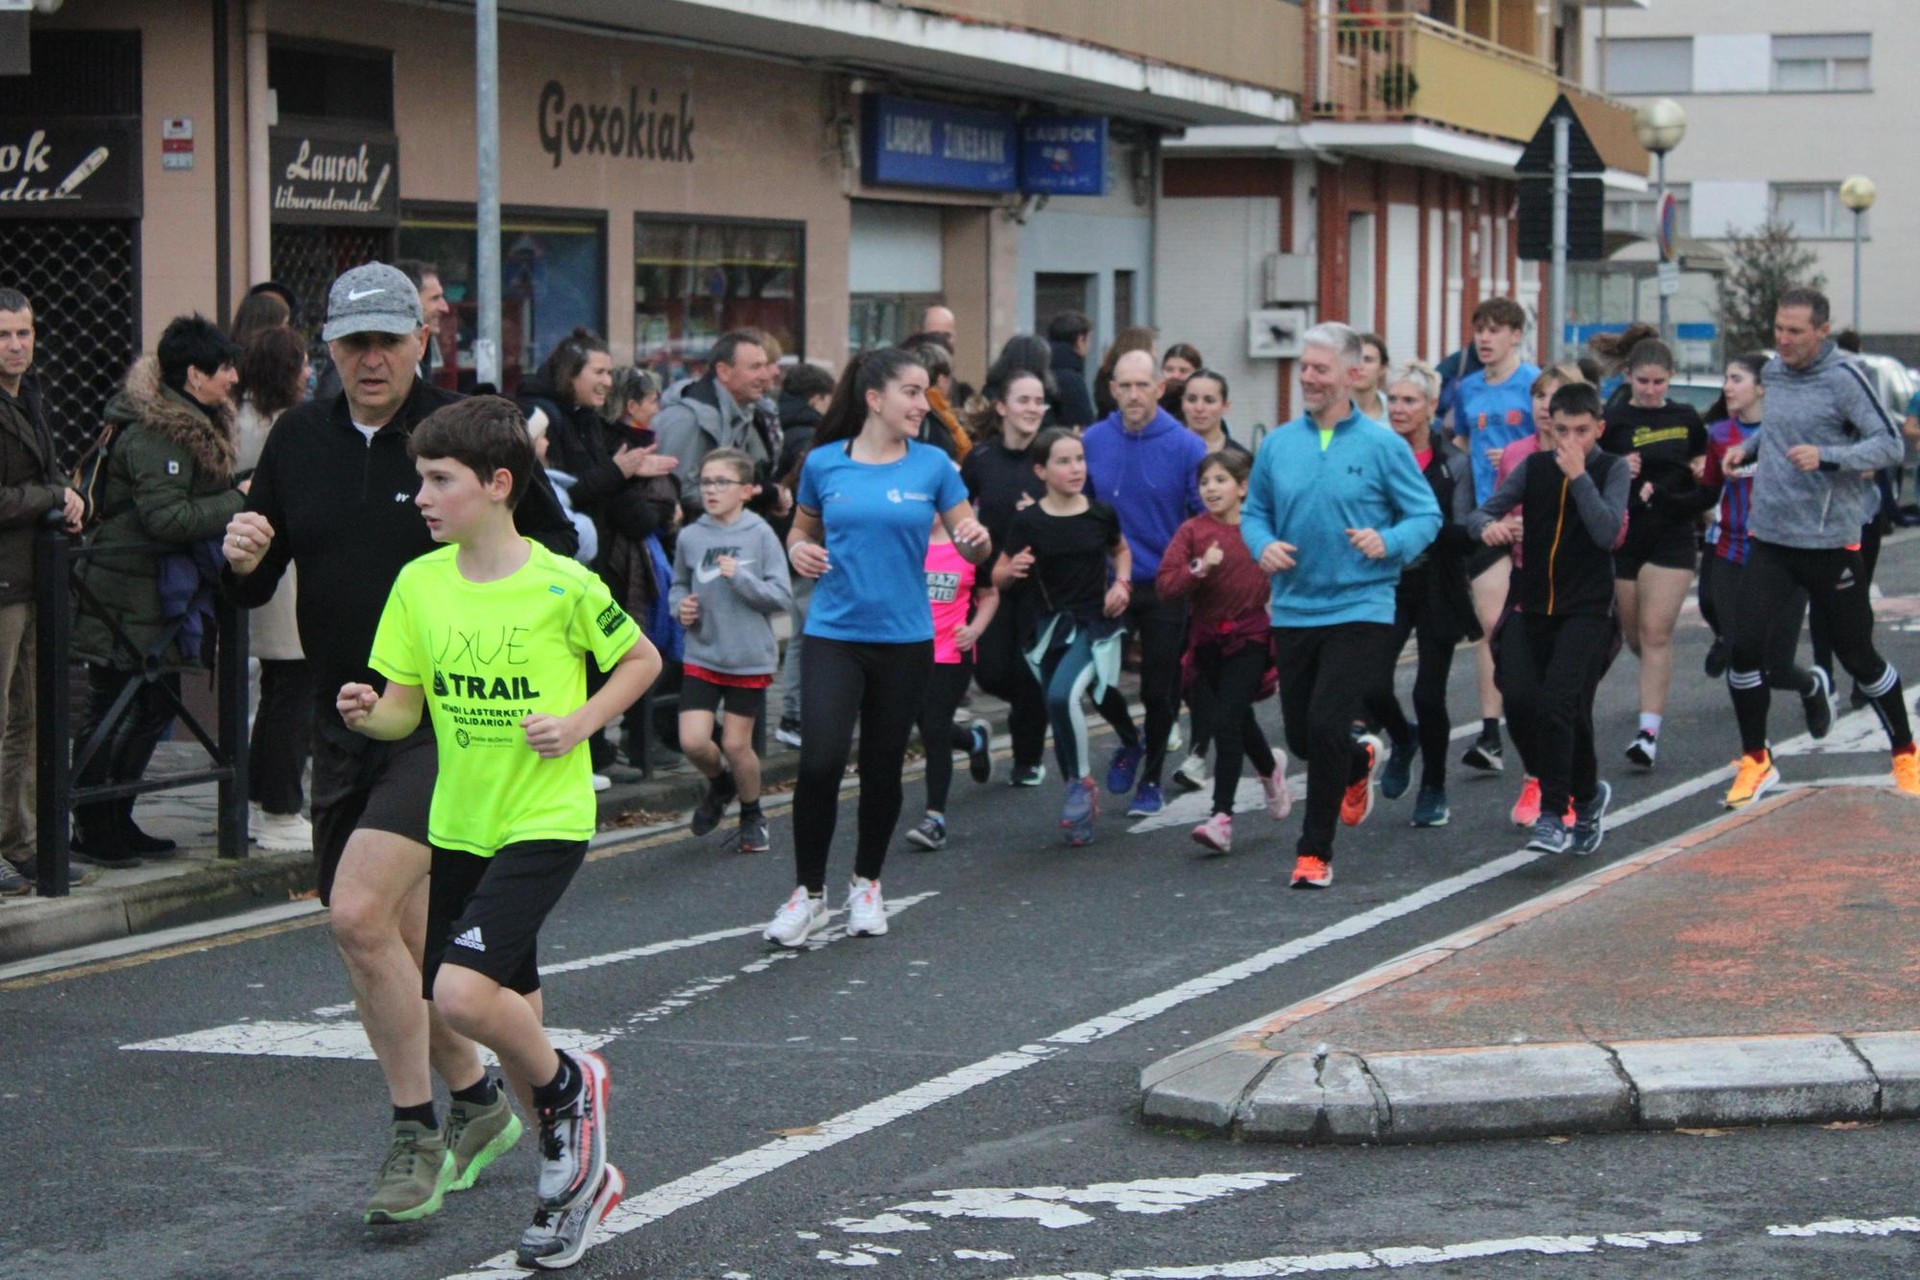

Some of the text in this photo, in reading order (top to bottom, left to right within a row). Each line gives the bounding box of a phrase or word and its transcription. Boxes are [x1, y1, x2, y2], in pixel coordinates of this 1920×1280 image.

[538, 80, 695, 168] Goxokiak
[286, 139, 369, 183] Laurok
[275, 185, 369, 212] liburudenda
[428, 625, 529, 673] UXUE
[449, 672, 540, 700] TRAIL
[453, 715, 512, 727] SOLIDARIOA
[464, 707, 533, 717] LASTERKETA
